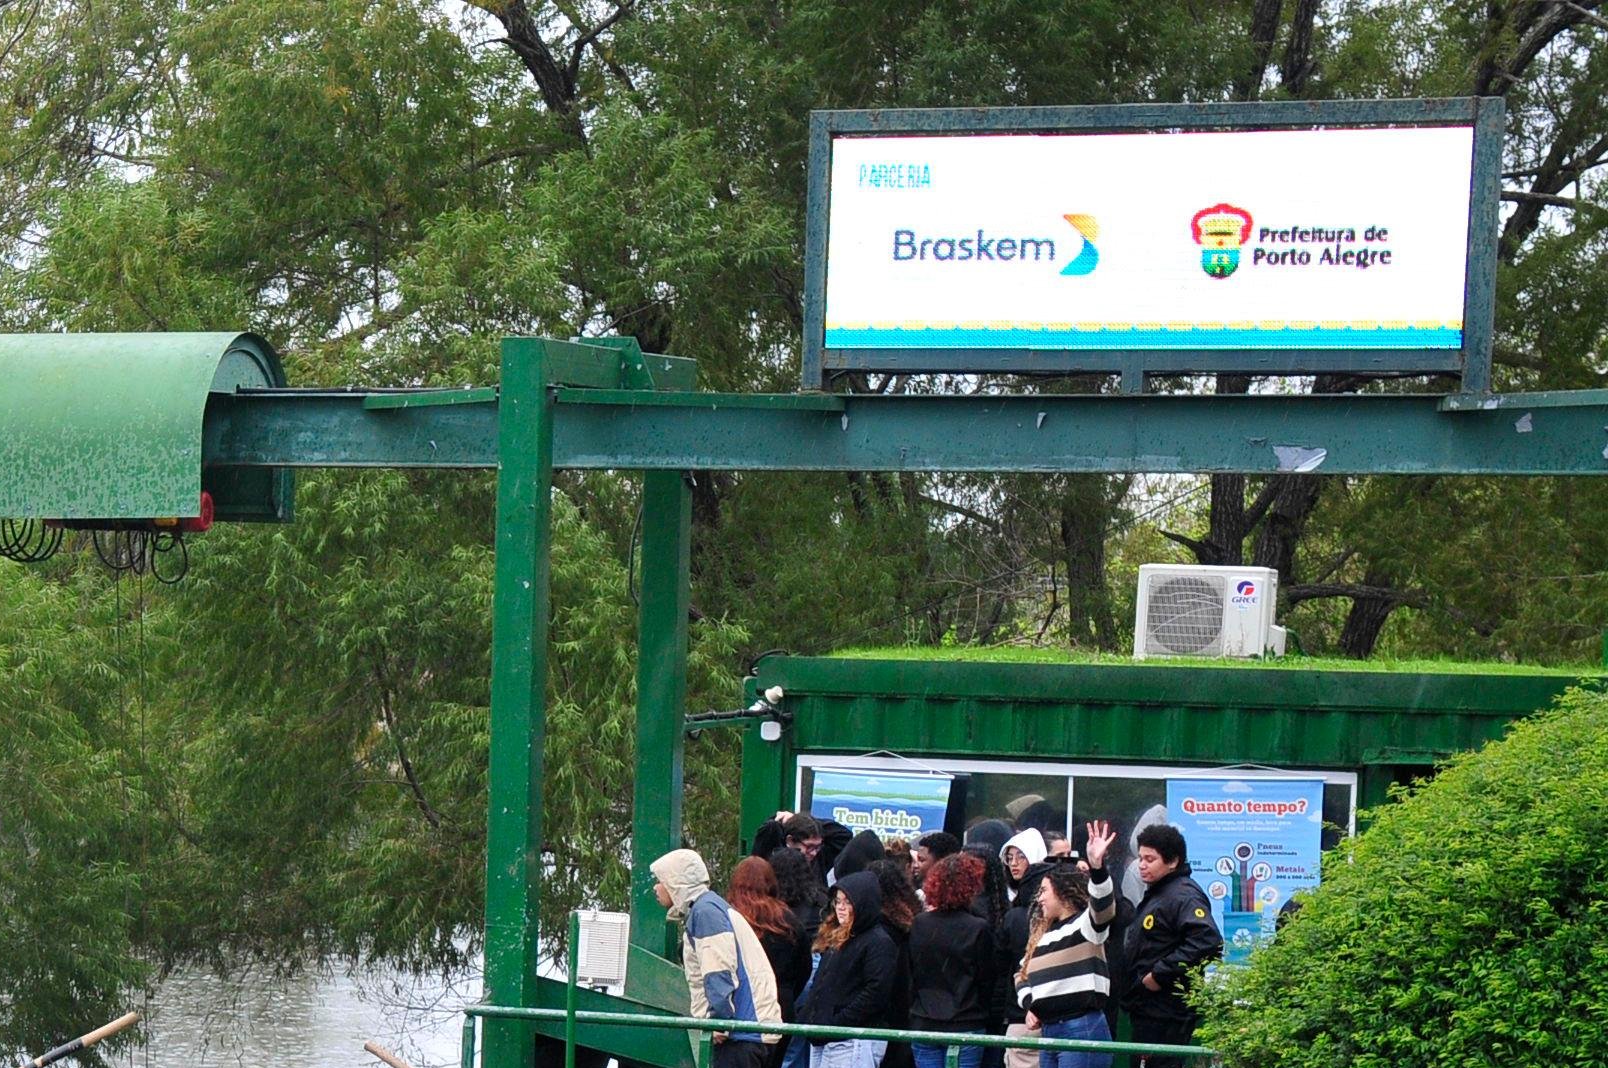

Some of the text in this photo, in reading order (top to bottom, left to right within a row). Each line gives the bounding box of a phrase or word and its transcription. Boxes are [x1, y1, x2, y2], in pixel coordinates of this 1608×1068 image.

[859, 163, 931, 188] PARCERIA
[893, 229, 1056, 261] Braskem
[1259, 225, 1389, 243] Prefeitura de
[1252, 243, 1392, 268] Porto Alegre
[835, 809, 920, 828] Tem bicho
[1183, 800, 1307, 817] Quanto tempo?
